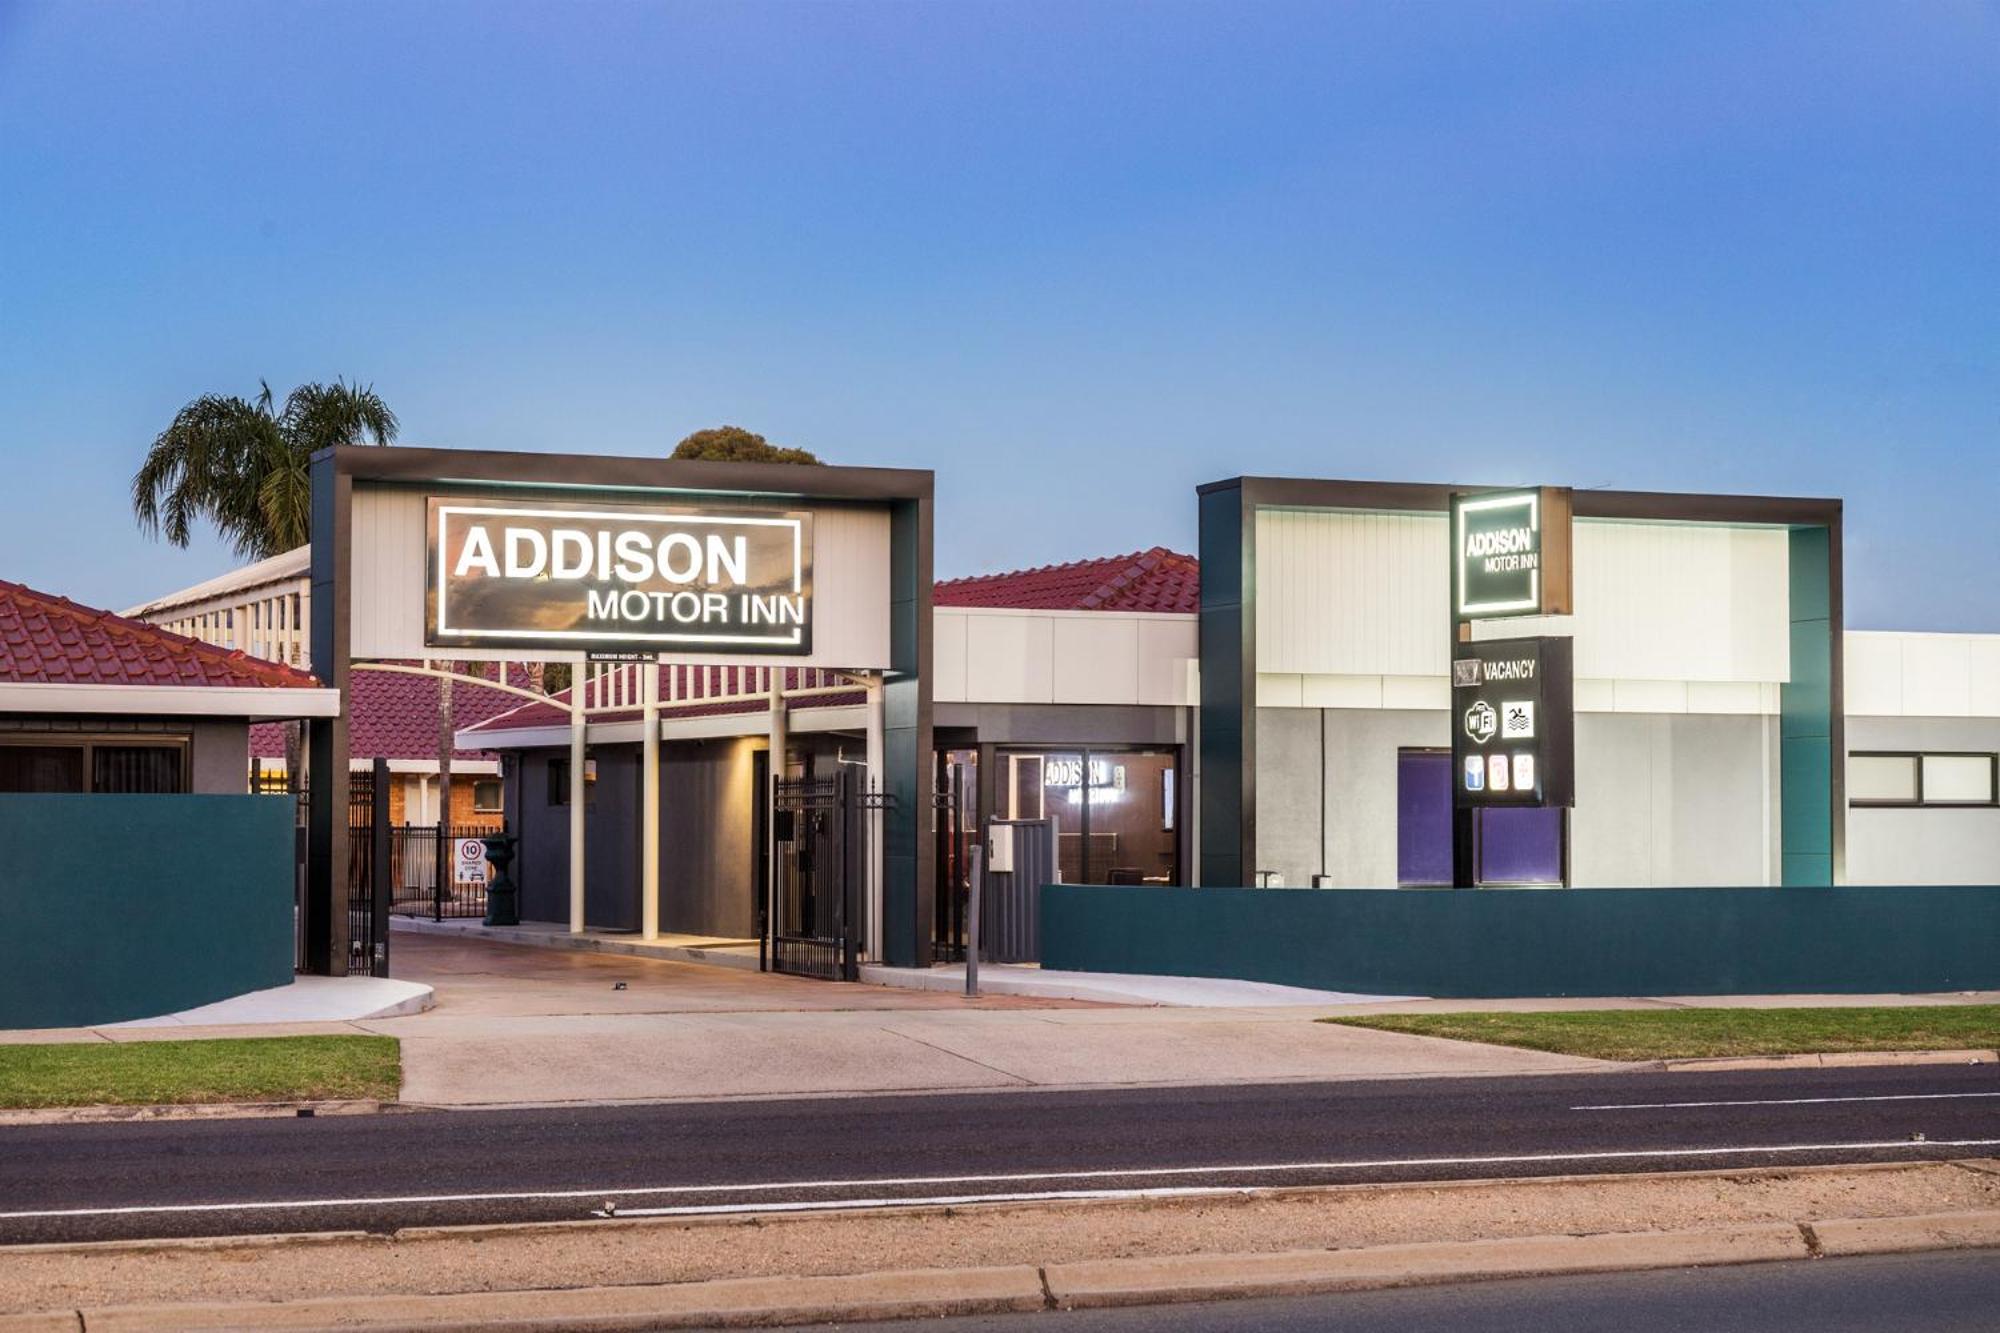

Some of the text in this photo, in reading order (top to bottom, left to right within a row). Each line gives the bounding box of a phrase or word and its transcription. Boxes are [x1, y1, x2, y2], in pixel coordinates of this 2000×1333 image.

[1466, 527, 1531, 557] ADDISON
[454, 525, 747, 586] ADDISON
[1484, 553, 1538, 574] MOTOR INN
[586, 589, 805, 625] MOTOR INN
[1483, 659, 1536, 681] VACANCY
[1045, 761, 1100, 785] ADDISN
[465, 845, 477, 855] 10
